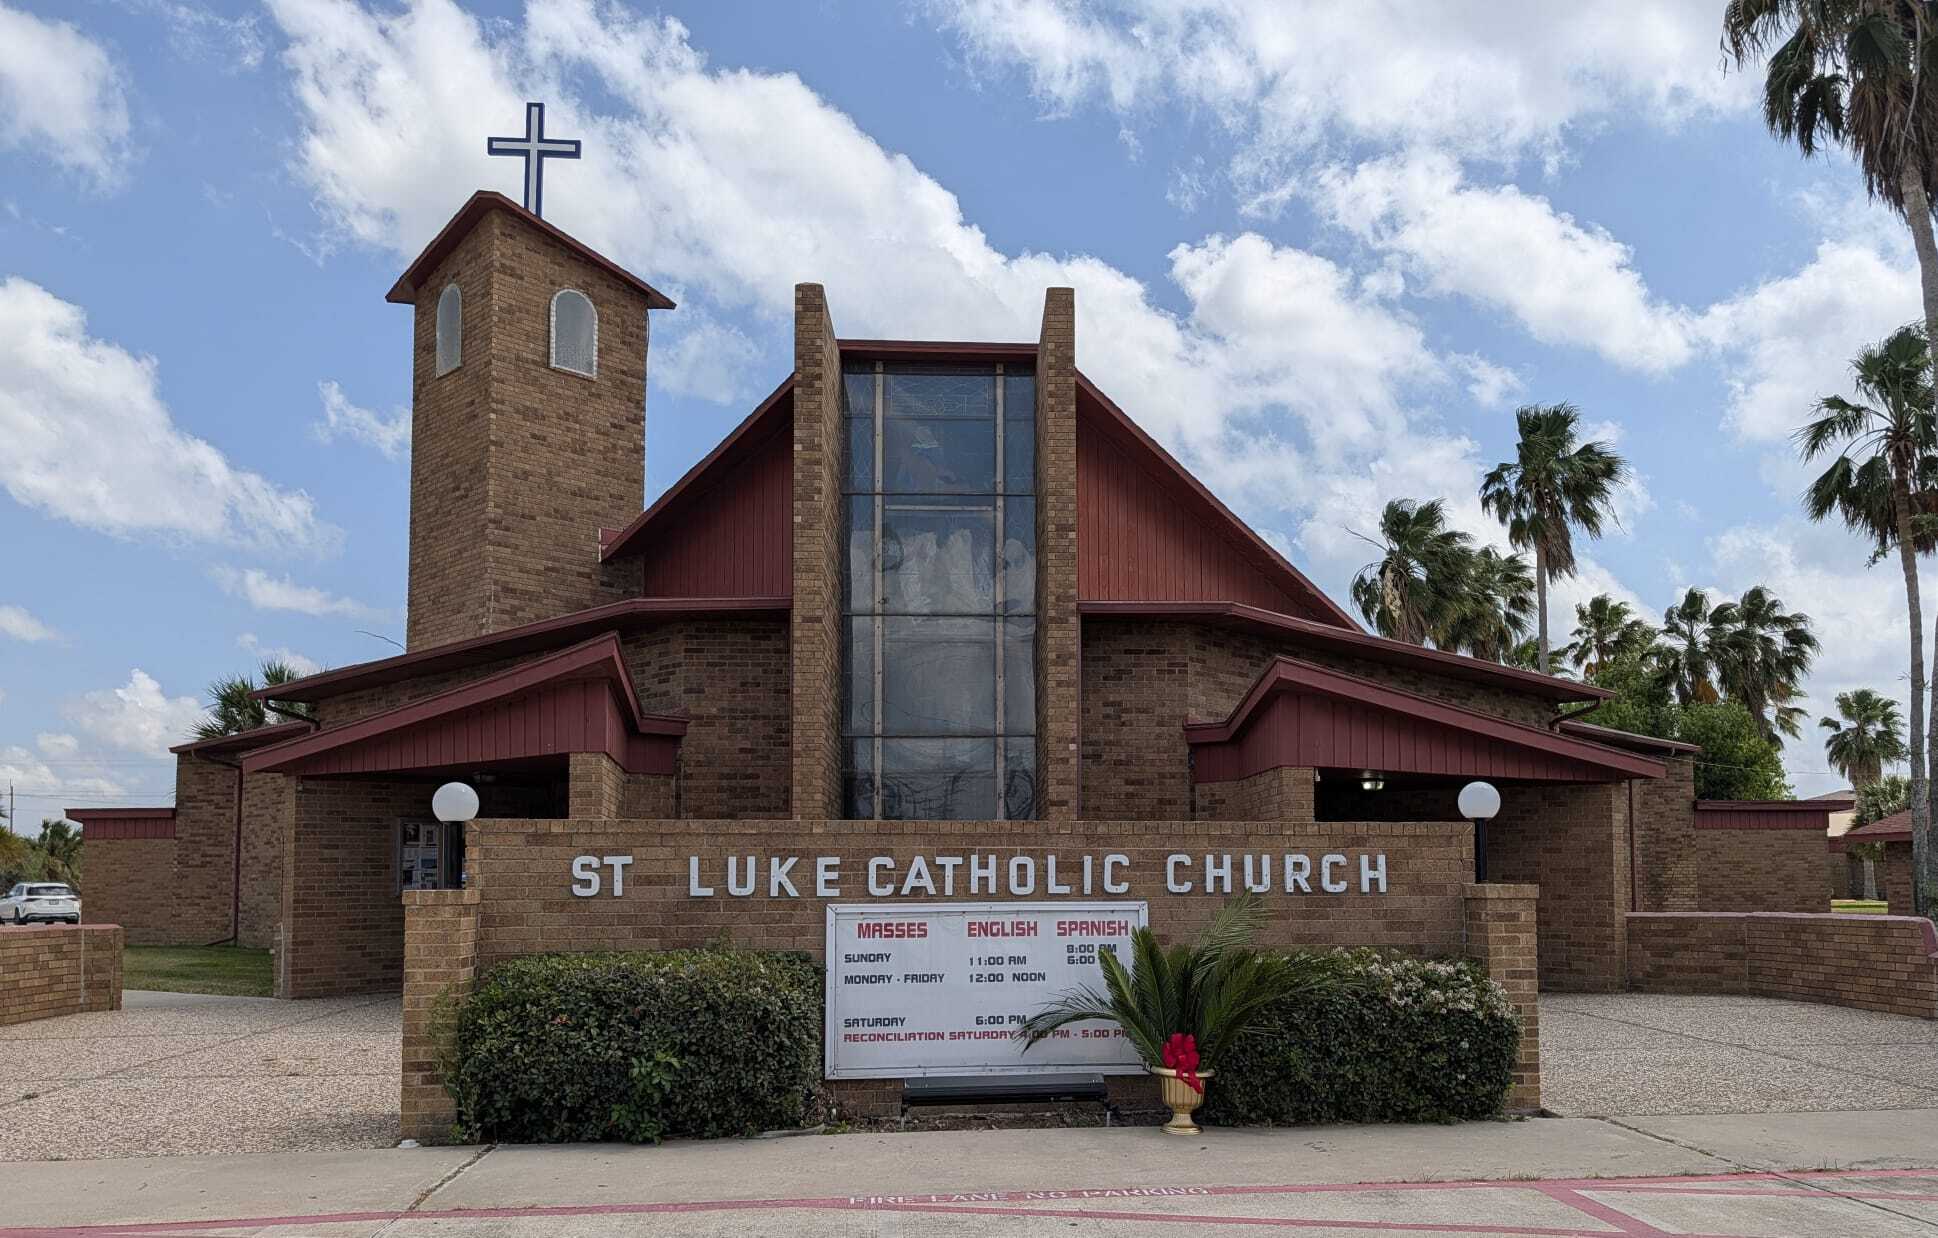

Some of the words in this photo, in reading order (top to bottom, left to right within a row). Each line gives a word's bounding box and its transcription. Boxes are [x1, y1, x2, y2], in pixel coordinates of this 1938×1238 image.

[572, 855, 633, 897] ST
[689, 855, 841, 897] LUKE
[868, 854, 1130, 896] CATHOLIC
[1166, 854, 1387, 893] CHURCH
[857, 922, 928, 938] MASSES
[967, 921, 1038, 937] ENGLISH
[1056, 920, 1129, 936] SPANISH
[1066, 944, 1095, 953] 8:00
[844, 953, 892, 963] SUNDAY
[969, 956, 1005, 966] 11:00
[1008, 956, 1027, 965] AM
[844, 974, 893, 985] MONDAY
[903, 973, 945, 984] FRIDAY
[969, 973, 1005, 983] 12:00
[1012, 972, 1046, 982] NOON
[844, 1017, 906, 1028] SATURDAY
[975, 1016, 1005, 1025] 6:00
[1008, 1015, 1027, 1024] PM
[844, 1031, 945, 1042] RECONCILIATION
[949, 1029, 1015, 1040] SATURDAY
[1052, 1029, 1070, 1038] PM
[1081, 1029, 1110, 1038] 5:00
[850, 1195, 913, 1204] FIRE
[930, 1193, 1008, 1202] LANE
[1026, 1190, 1067, 1199] NO
[1082, 1187, 1209, 1198] PARKING
